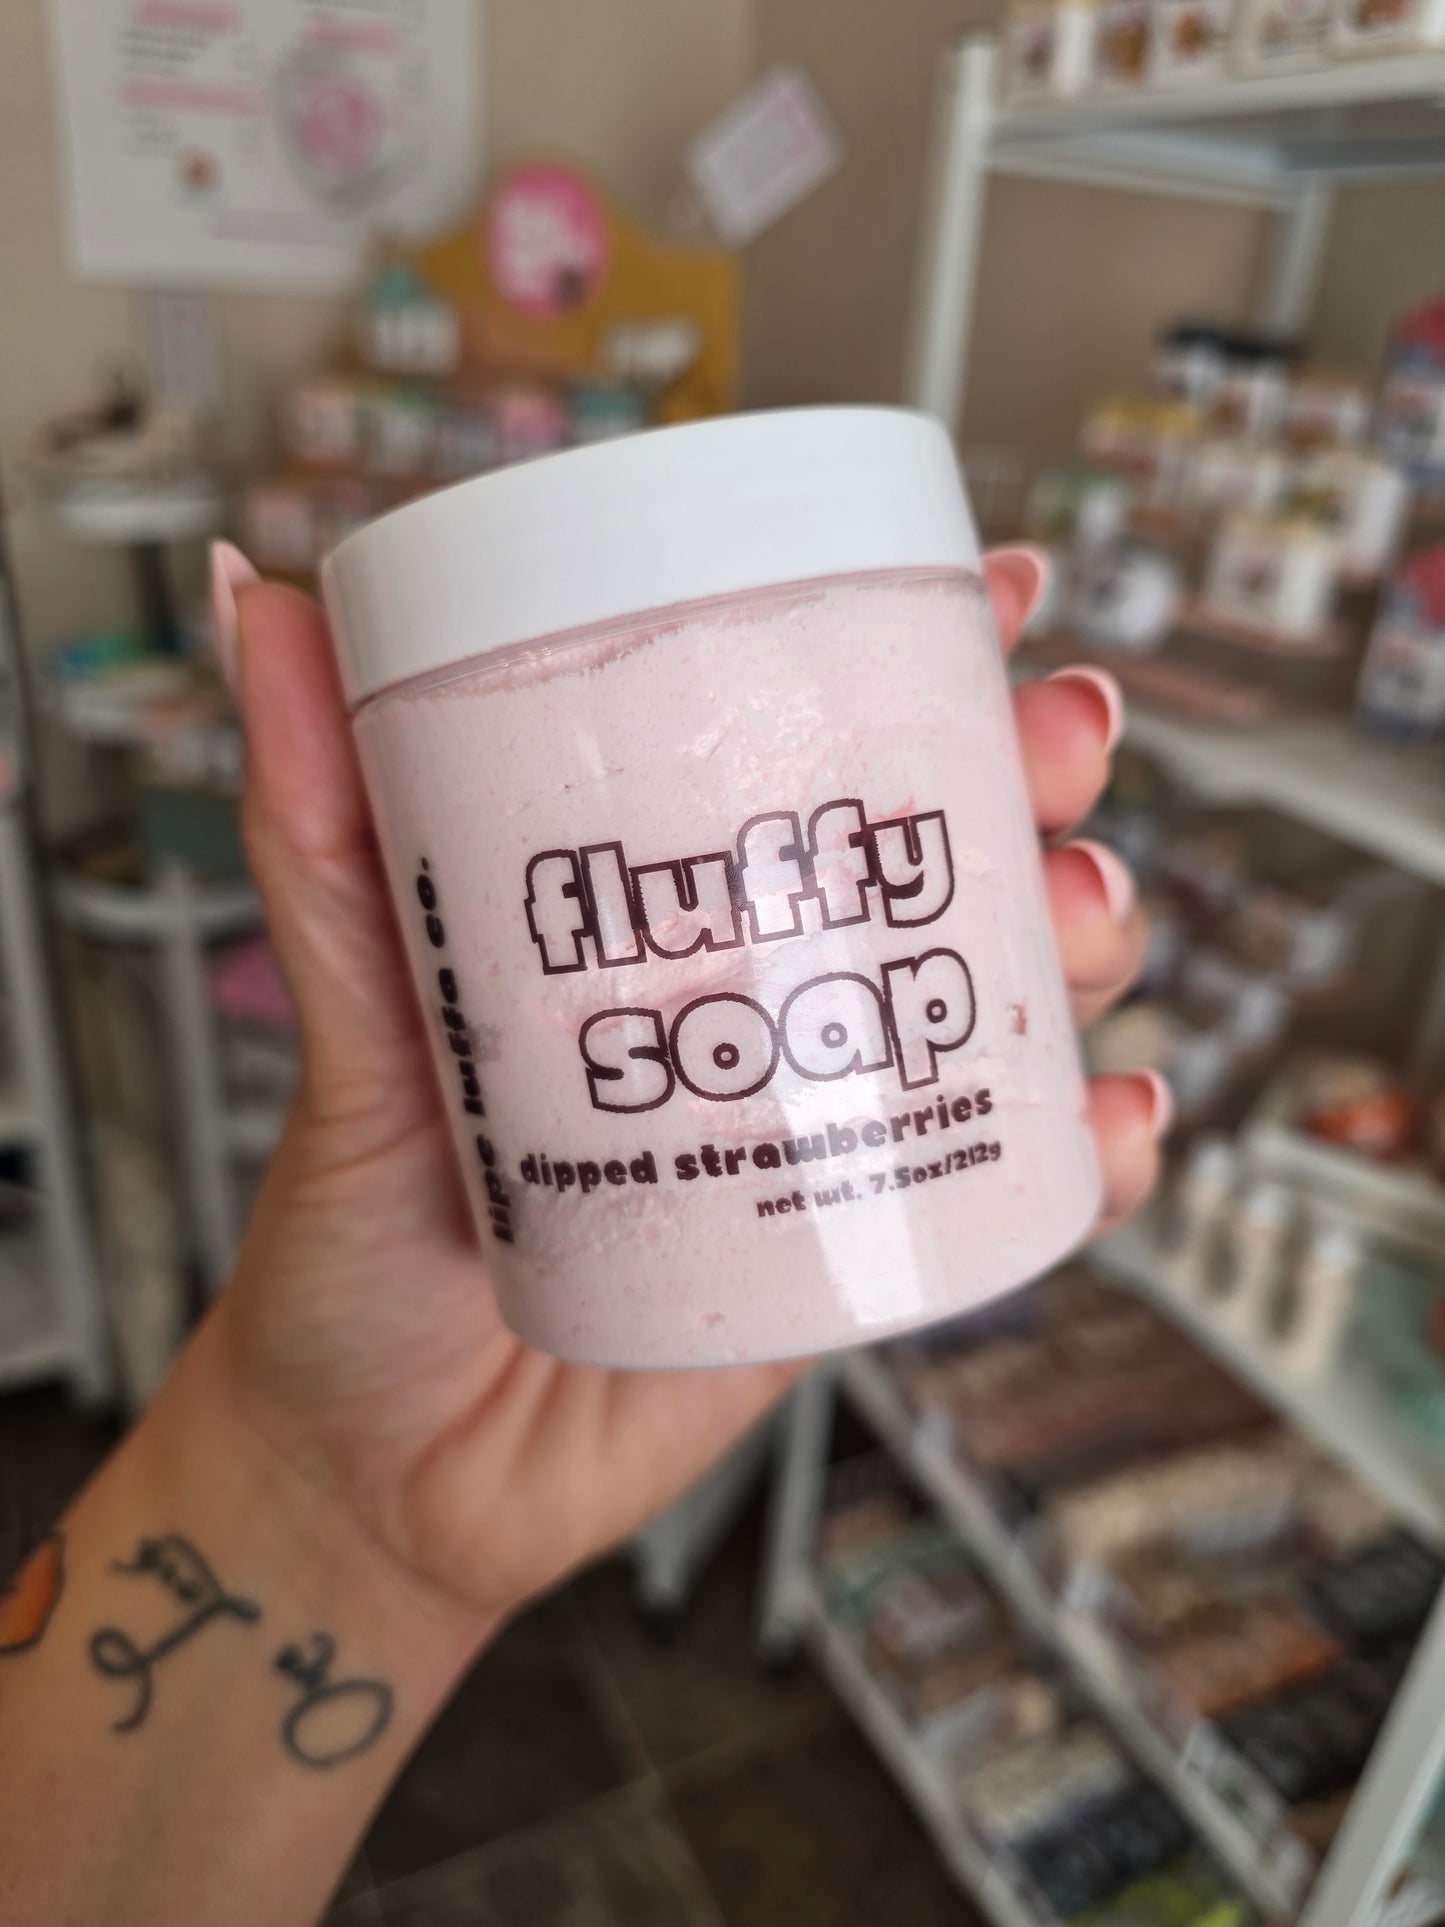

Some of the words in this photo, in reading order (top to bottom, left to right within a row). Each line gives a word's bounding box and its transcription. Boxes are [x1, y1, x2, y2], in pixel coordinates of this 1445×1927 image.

[416, 857, 446, 949] co.
[525, 798, 955, 976] fluffy
[438, 967, 487, 1117] luffa
[580, 947, 976, 1114] soap
[520, 1150, 659, 1193] dipped
[674, 1087, 993, 1181] strawberries
[757, 1189, 807, 1218] net
[813, 1180, 863, 1208] wt.
[868, 1140, 1002, 1194] 7.5oz/212g
